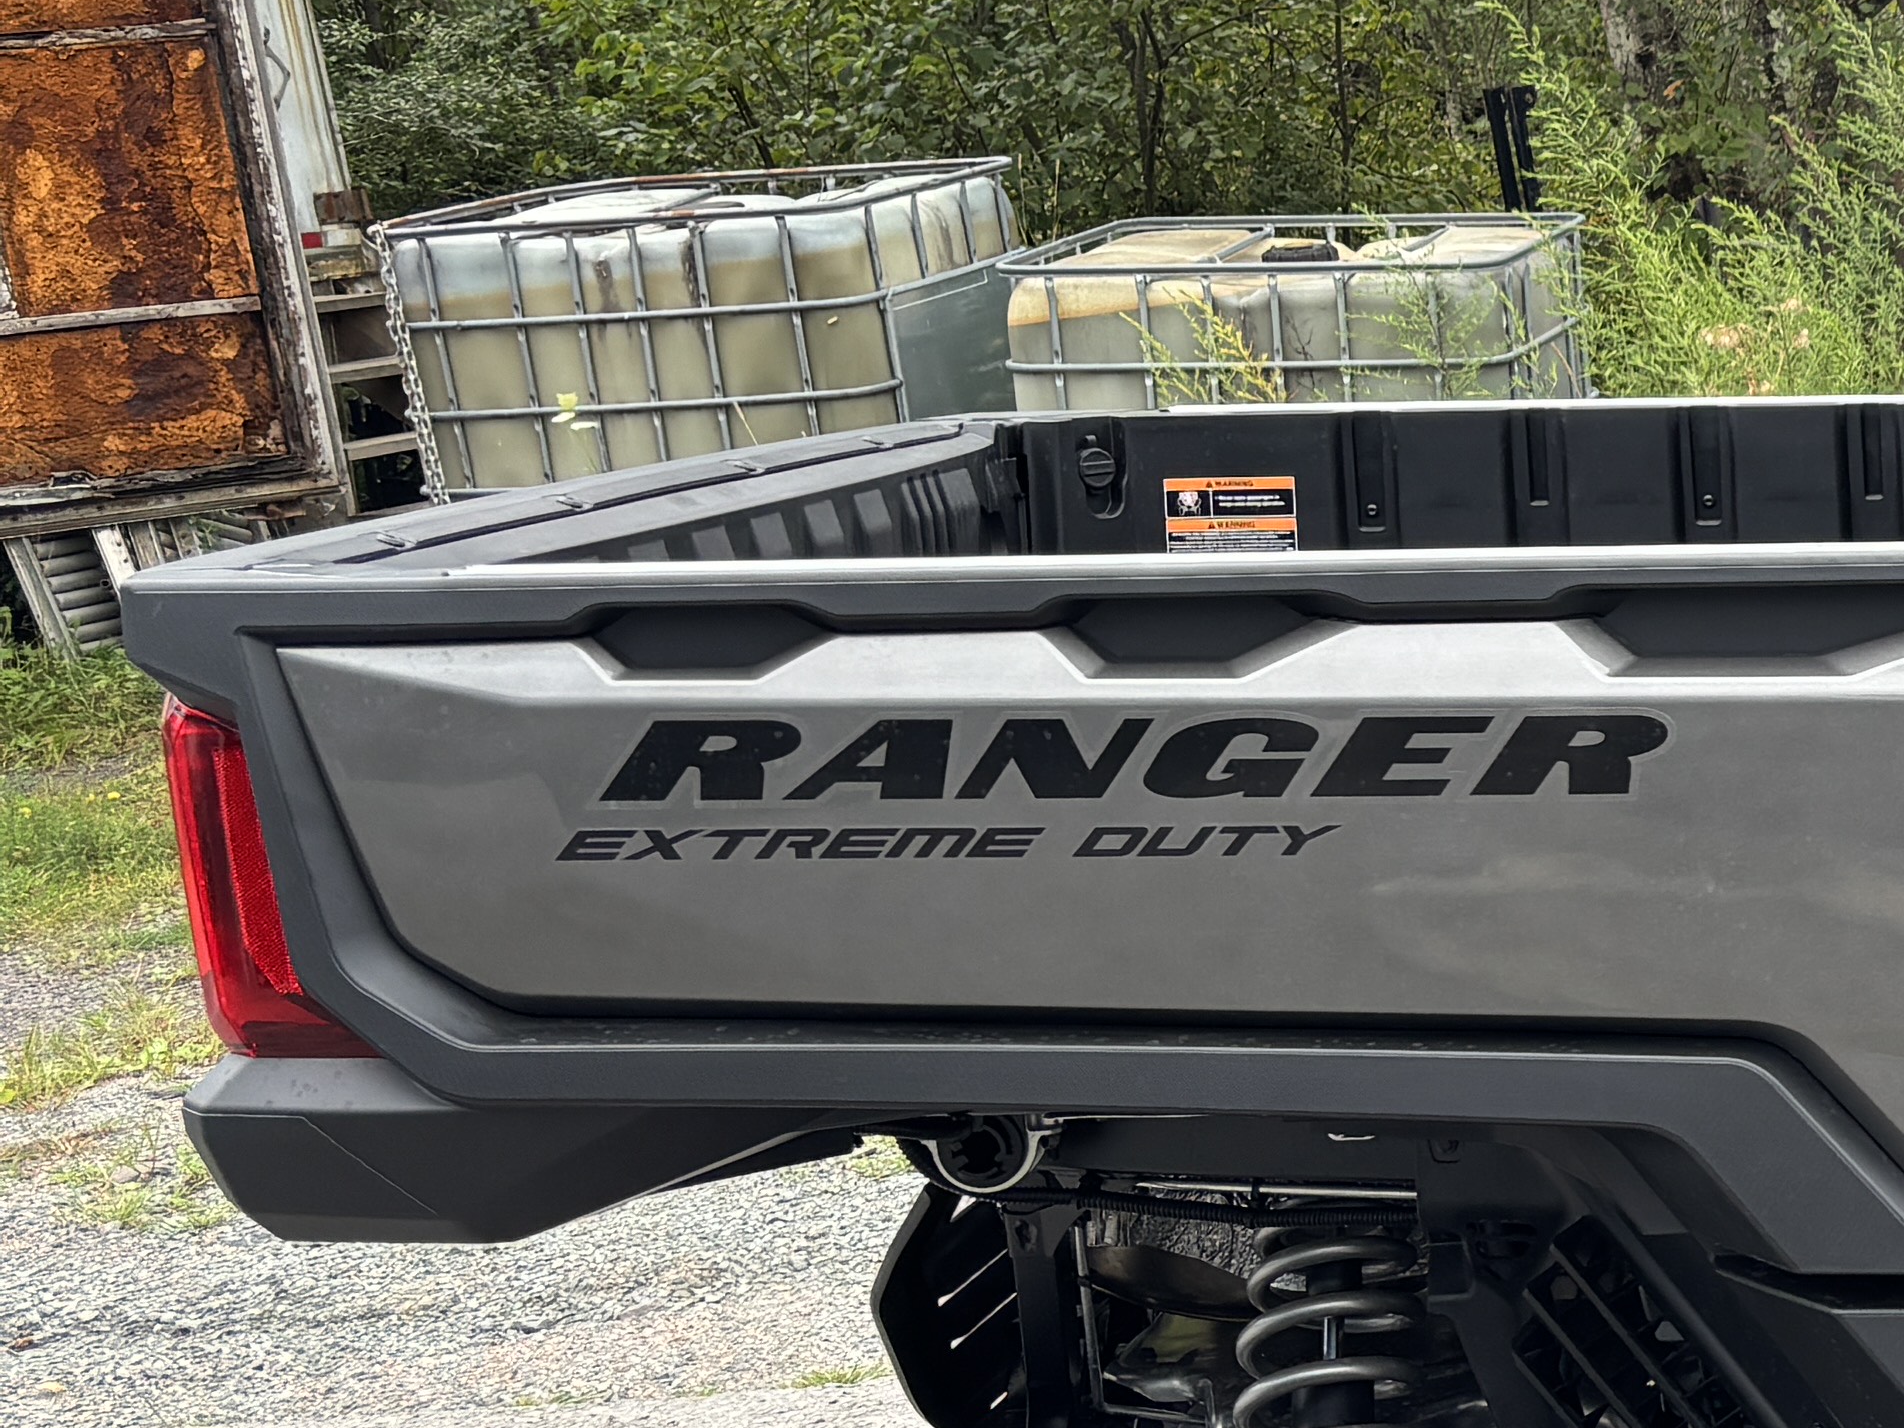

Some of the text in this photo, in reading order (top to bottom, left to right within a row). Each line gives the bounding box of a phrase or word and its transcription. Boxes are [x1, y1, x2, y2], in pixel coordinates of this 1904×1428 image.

[600, 715, 1674, 803] RANGER
[555, 823, 1342, 863] EXTREME DUTY
